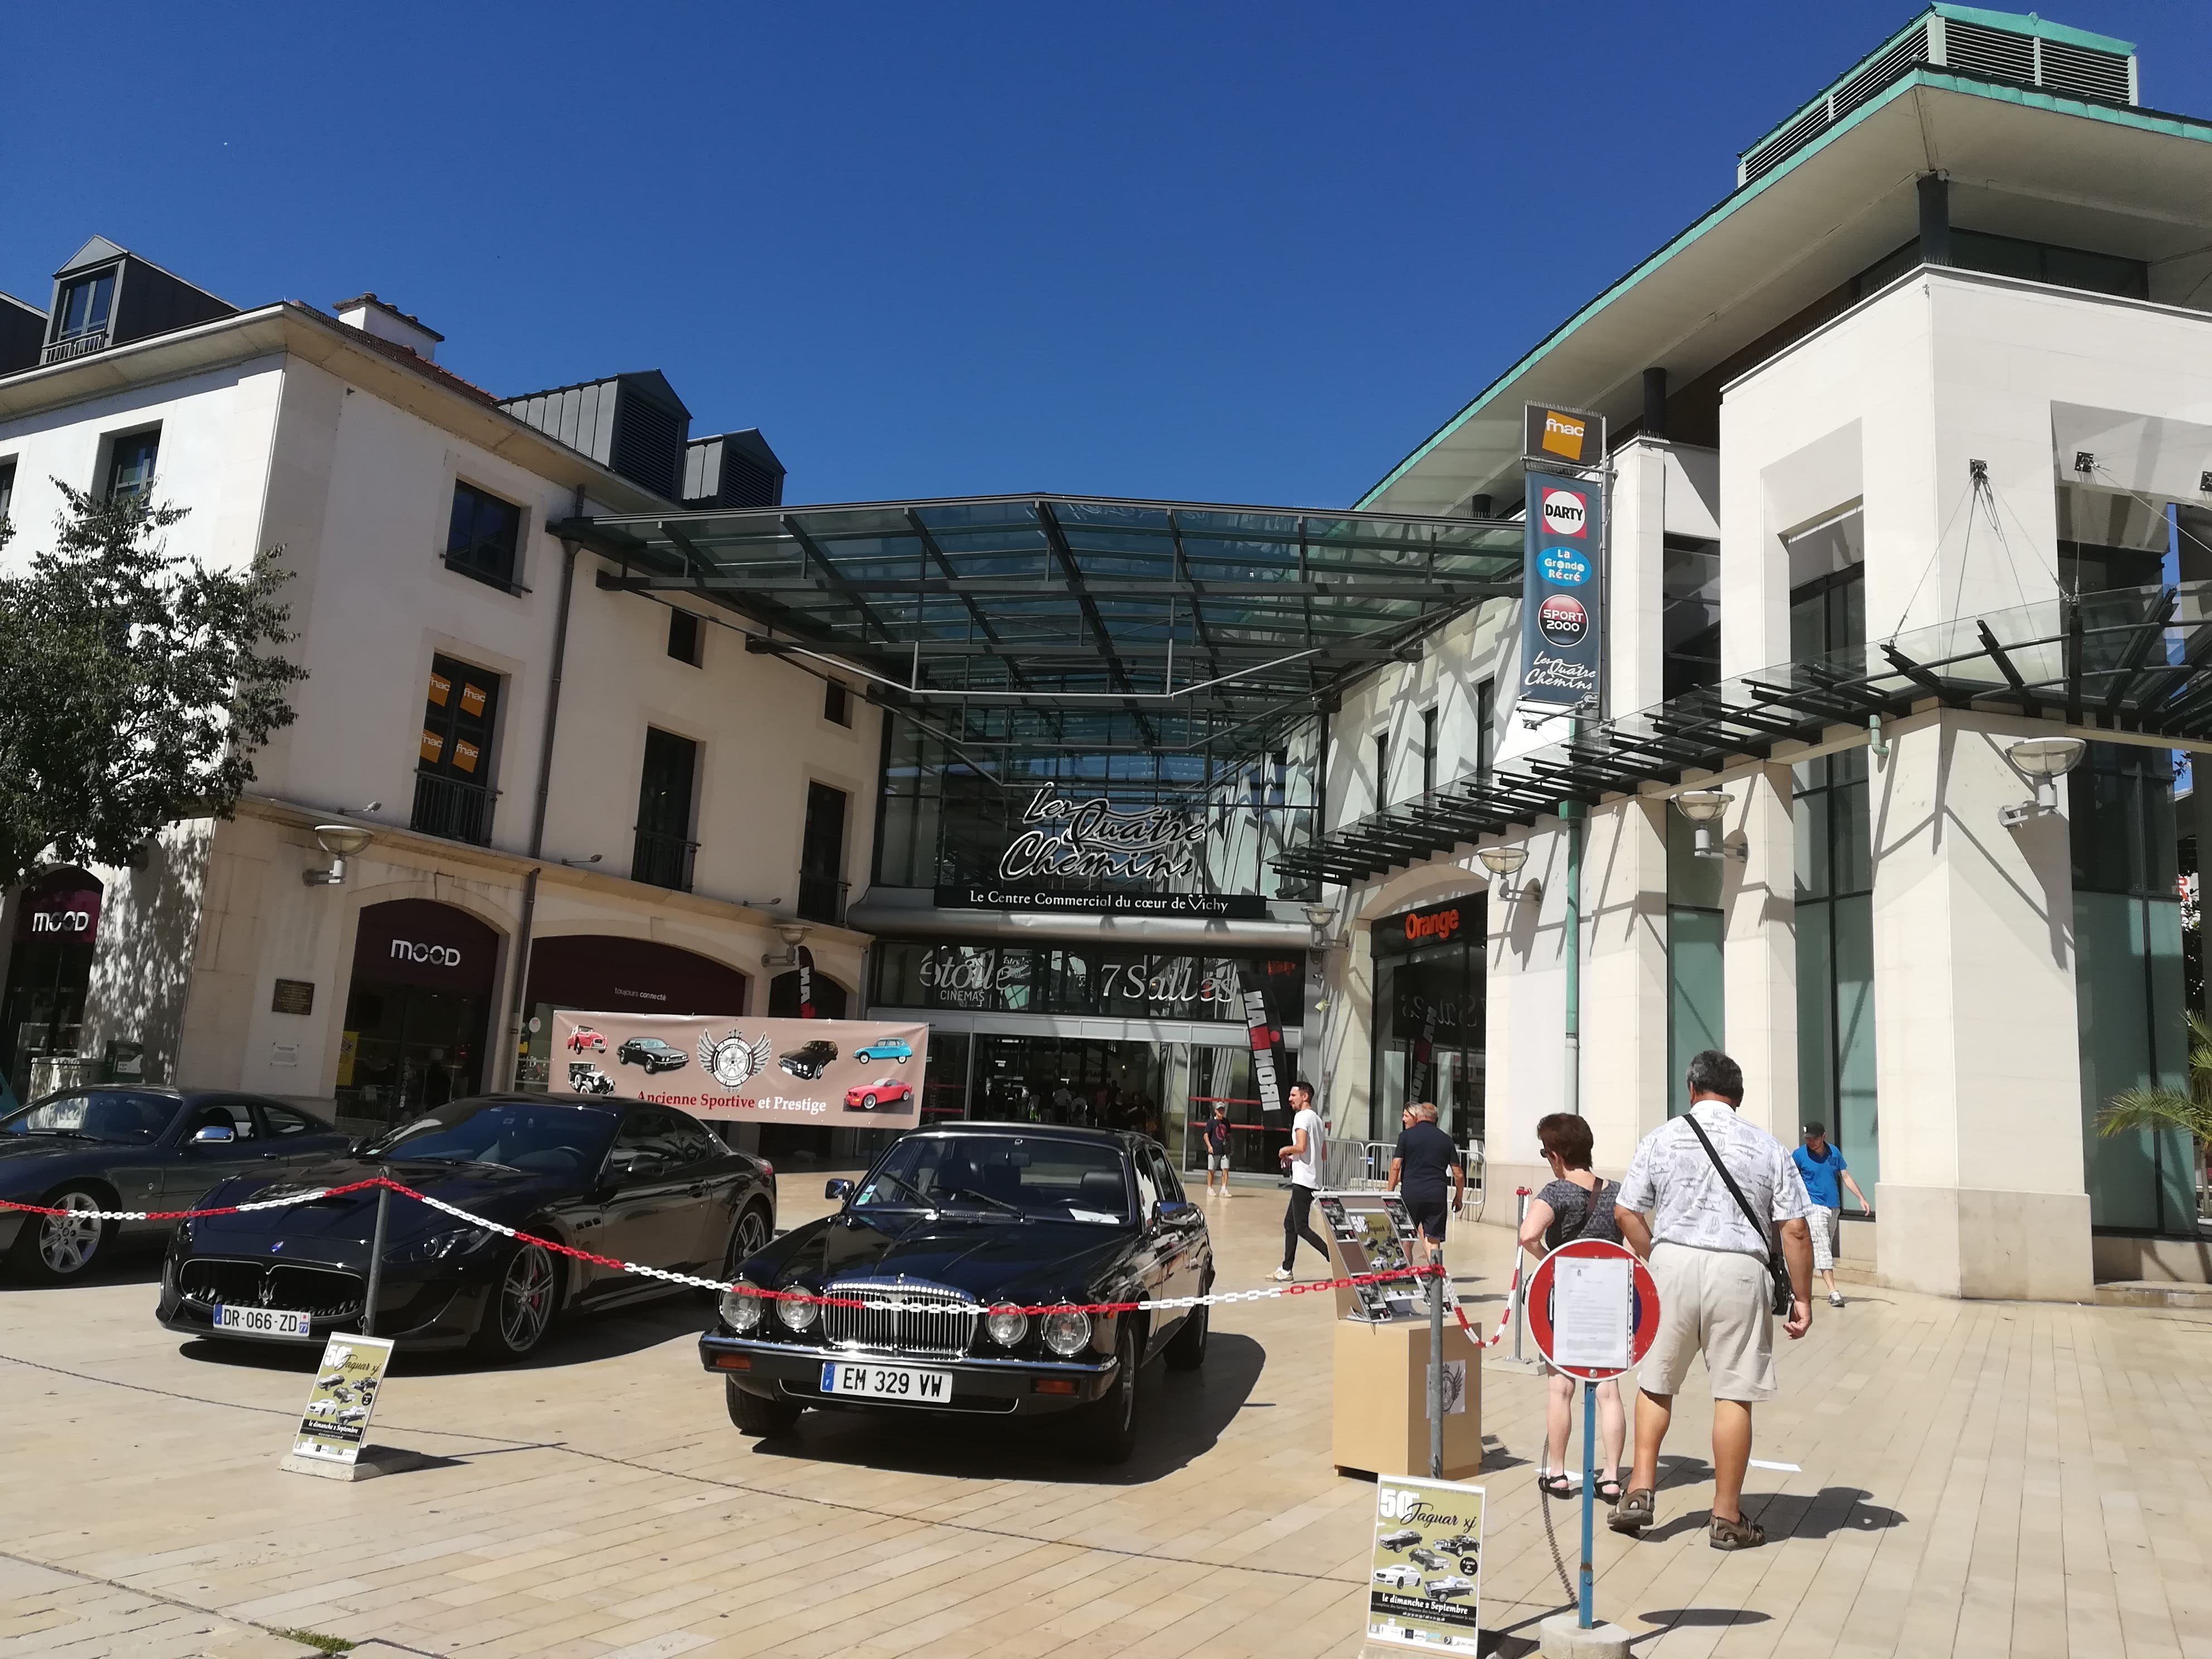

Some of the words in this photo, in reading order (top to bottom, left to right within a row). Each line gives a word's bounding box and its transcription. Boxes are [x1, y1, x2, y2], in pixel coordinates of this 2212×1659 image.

[1546, 419, 1584, 437] fnac
[1545, 504, 1583, 521] DARTY
[1557, 549, 1570, 559] La
[1544, 558, 1585, 572] Grande
[1549, 569, 1581, 581] Récré
[1543, 609, 1583, 622] SPORT
[1546, 620, 1580, 632] 2000
[1550, 657, 1596, 678] Quatre
[1524, 668, 1592, 691] Chemins
[464, 687, 486, 702] fnac
[455, 744, 478, 758] fnac
[1022, 782, 1071, 824] Les
[1061, 798, 1207, 853] Quatre
[1000, 830, 1195, 881] Chemins
[969, 890, 984, 903] Le
[988, 891, 1031, 905] Centre
[1035, 892, 1112, 908] Commercial
[1115, 895, 1131, 909] du
[1134, 899, 1167, 910] cœur
[1171, 897, 1186, 910] de
[1188, 894, 1229, 914] Vichy
[1405, 908, 1459, 940] Orange
[919, 949, 1012, 991] étoile
[1100, 964, 1121, 998] 7
[1123, 965, 1237, 1003] Salles
[614, 987, 639, 997] toujours
[639, 990, 667, 1002] connecté
[940, 989, 985, 1002] CINEMAS
[638, 1092, 696, 1105] Ancienne
[700, 1093, 755, 1109] Sportive
[758, 1096, 770, 1109] et
[773, 1097, 826, 1114] Prestige
[224, 1308, 297, 1332] DR-066-ZD
[299, 1324, 307, 1333] 77
[334, 1354, 370, 1373] Jaguar
[843, 1367, 867, 1391] EM
[874, 1371, 910, 1394] 329
[920, 1374, 943, 1398] VW
[1400, 1502, 1459, 1528] Jaguar
[1382, 1593, 1389, 1603] le
[1390, 1594, 1424, 1608] dimanche
[1431, 1602, 1468, 1615] Septembre
